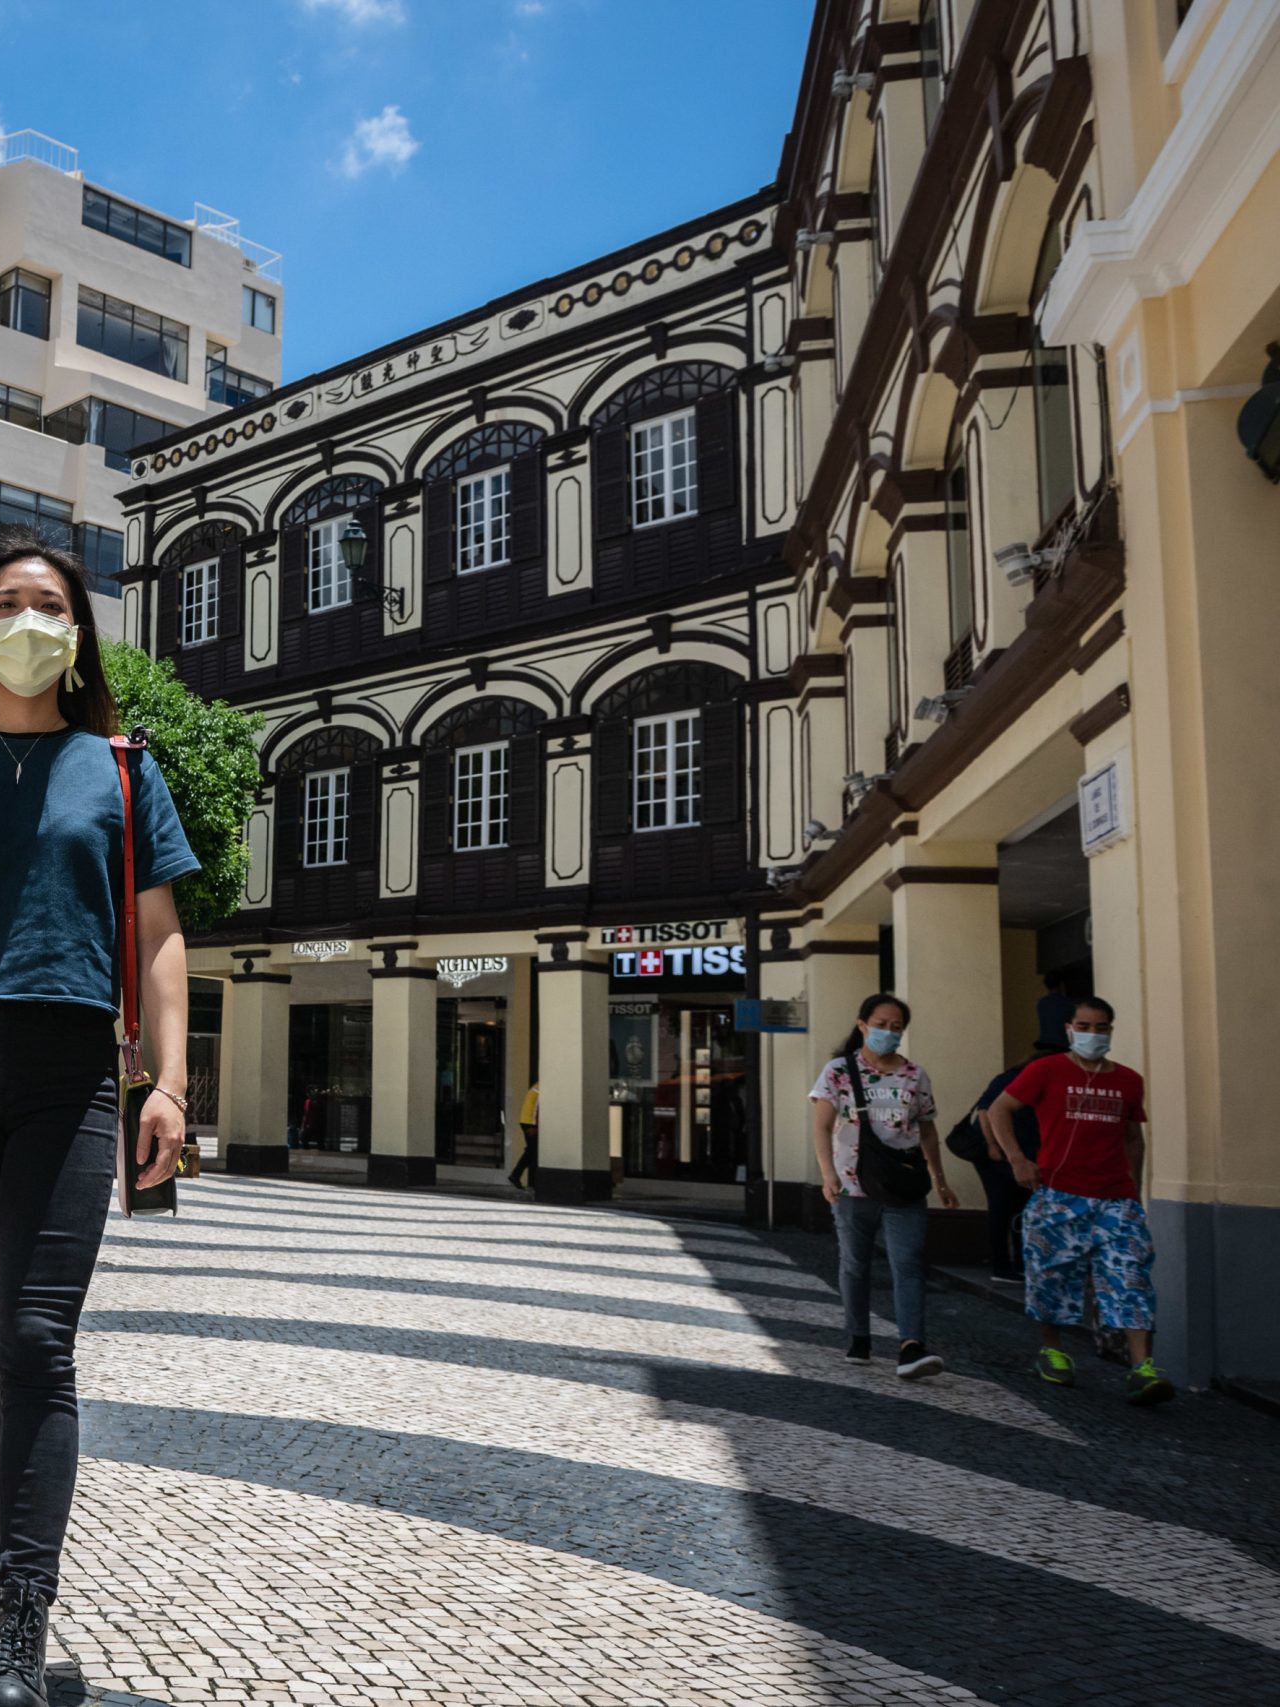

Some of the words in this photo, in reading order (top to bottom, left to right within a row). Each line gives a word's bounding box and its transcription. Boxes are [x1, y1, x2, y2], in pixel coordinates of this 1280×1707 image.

[633, 921, 728, 943] TISSOT
[291, 941, 349, 954] LONGINES
[436, 957, 508, 973] NGINES
[663, 944, 747, 976] TISS
[1066, 1085, 1122, 1098] SUMMER
